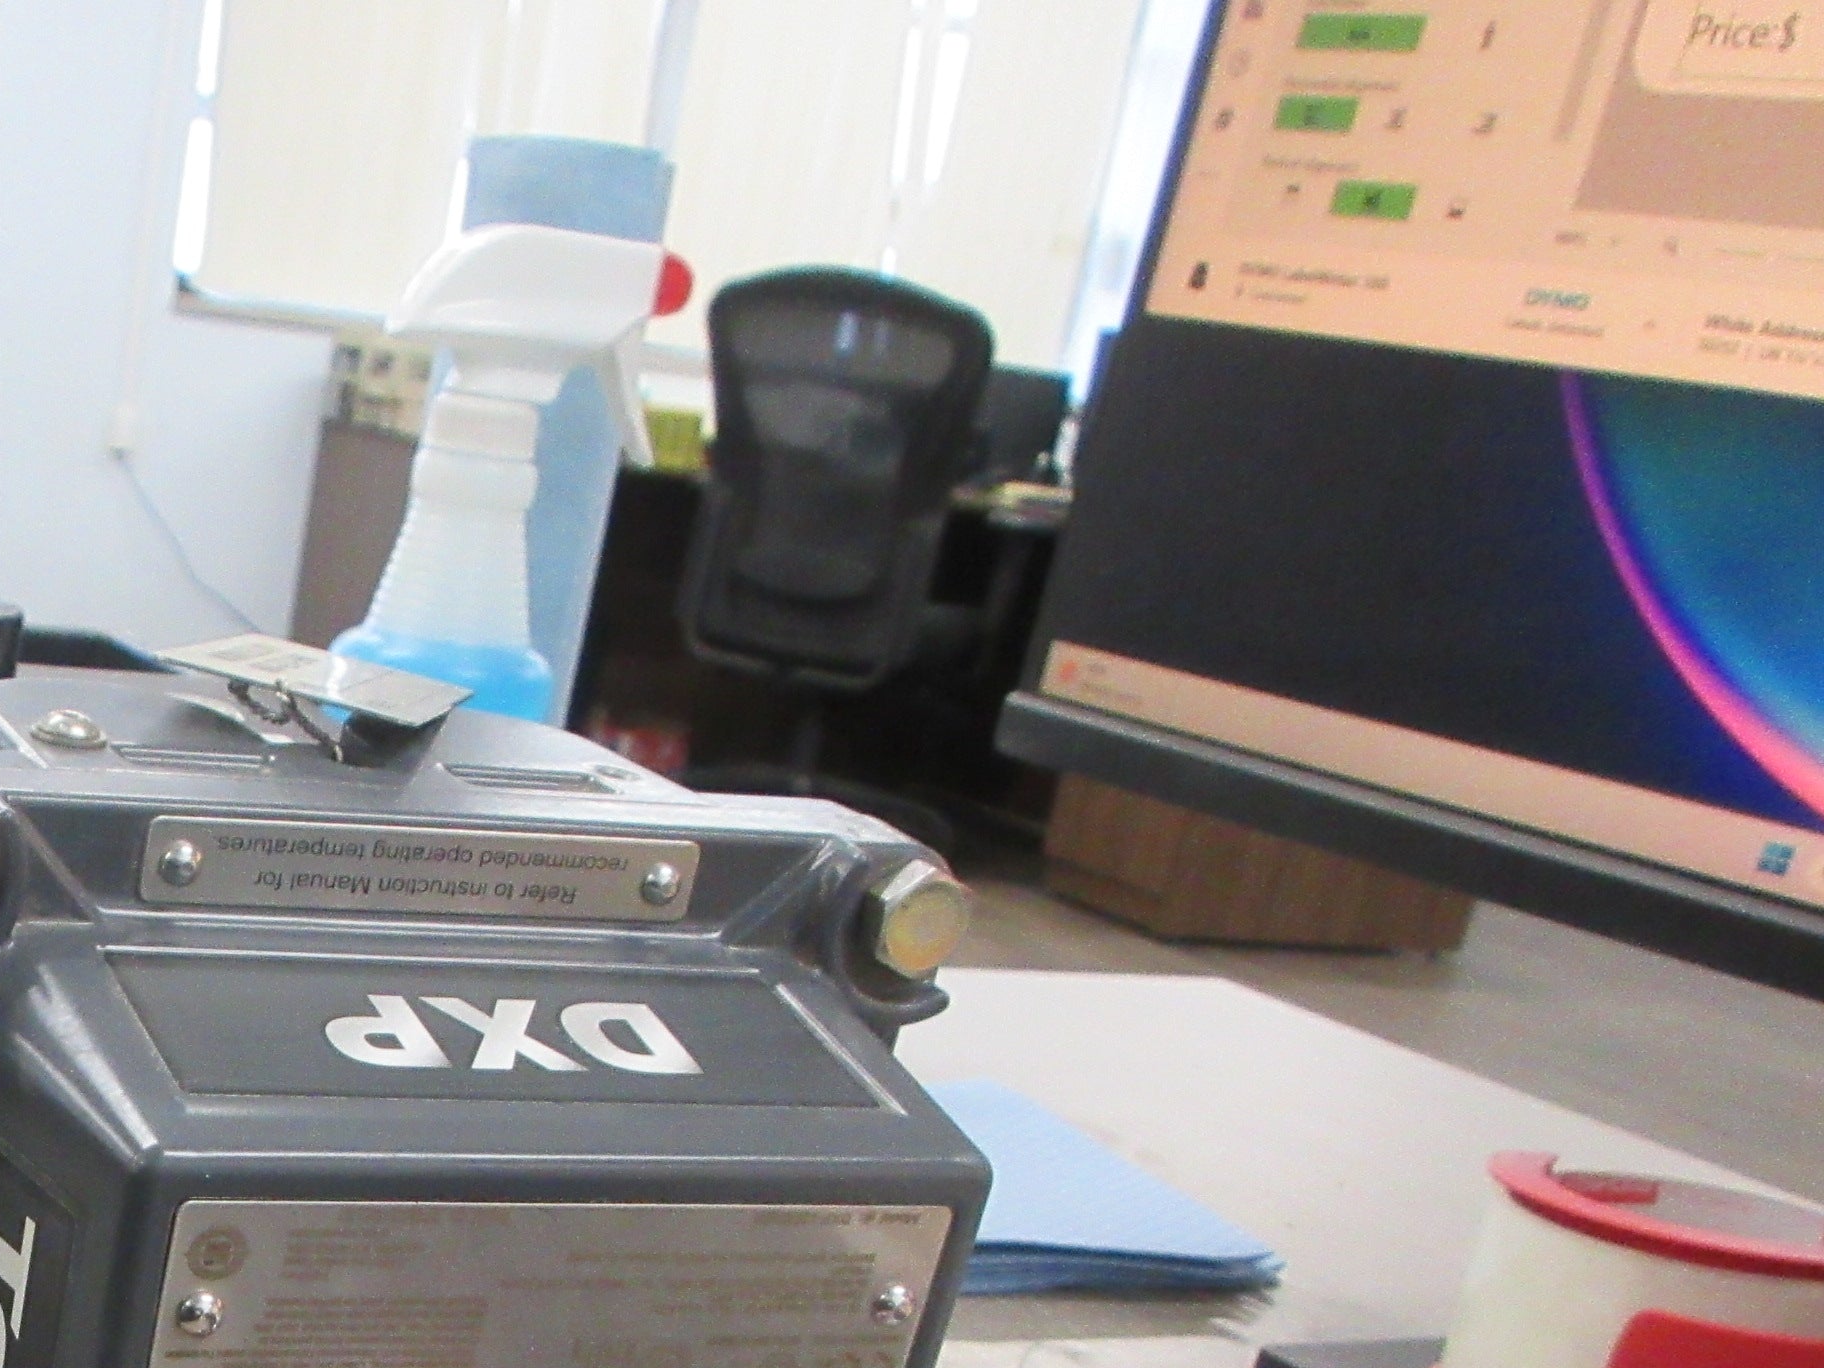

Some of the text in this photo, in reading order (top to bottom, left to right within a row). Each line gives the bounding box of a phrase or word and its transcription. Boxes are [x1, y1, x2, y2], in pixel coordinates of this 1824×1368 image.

[371, 841, 474, 864] operating
[478, 848, 629, 873] recommended
[253, 870, 282, 890] for
[290, 870, 371, 895] Manual
[493, 883, 514, 900] to
[519, 885, 577, 905] Refer
[325, 994, 704, 1074] DXP
